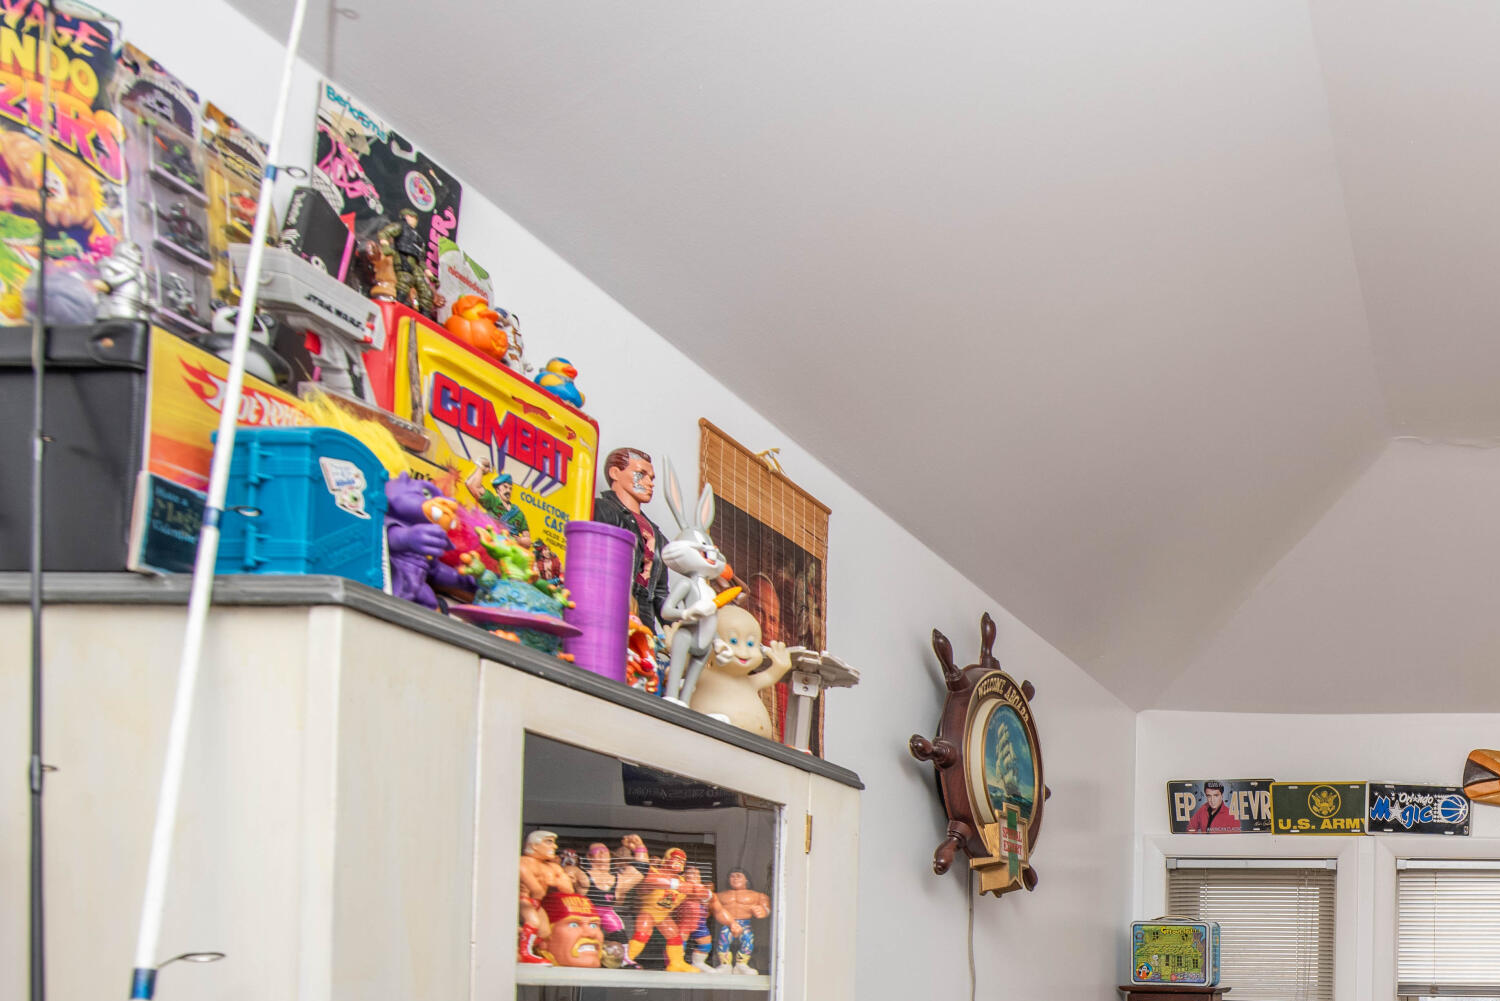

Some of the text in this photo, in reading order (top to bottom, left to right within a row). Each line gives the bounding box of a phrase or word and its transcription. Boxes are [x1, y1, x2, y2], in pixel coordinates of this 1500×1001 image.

[431, 371, 574, 486] COMBAT
[544, 514, 566, 533] CAS
[977, 676, 1030, 723] WELCOME ABOARD
[1174, 790, 1271, 822] EP 4EVR
[1398, 791, 1434, 804] Orlando
[1278, 817, 1316, 831] U.S.
